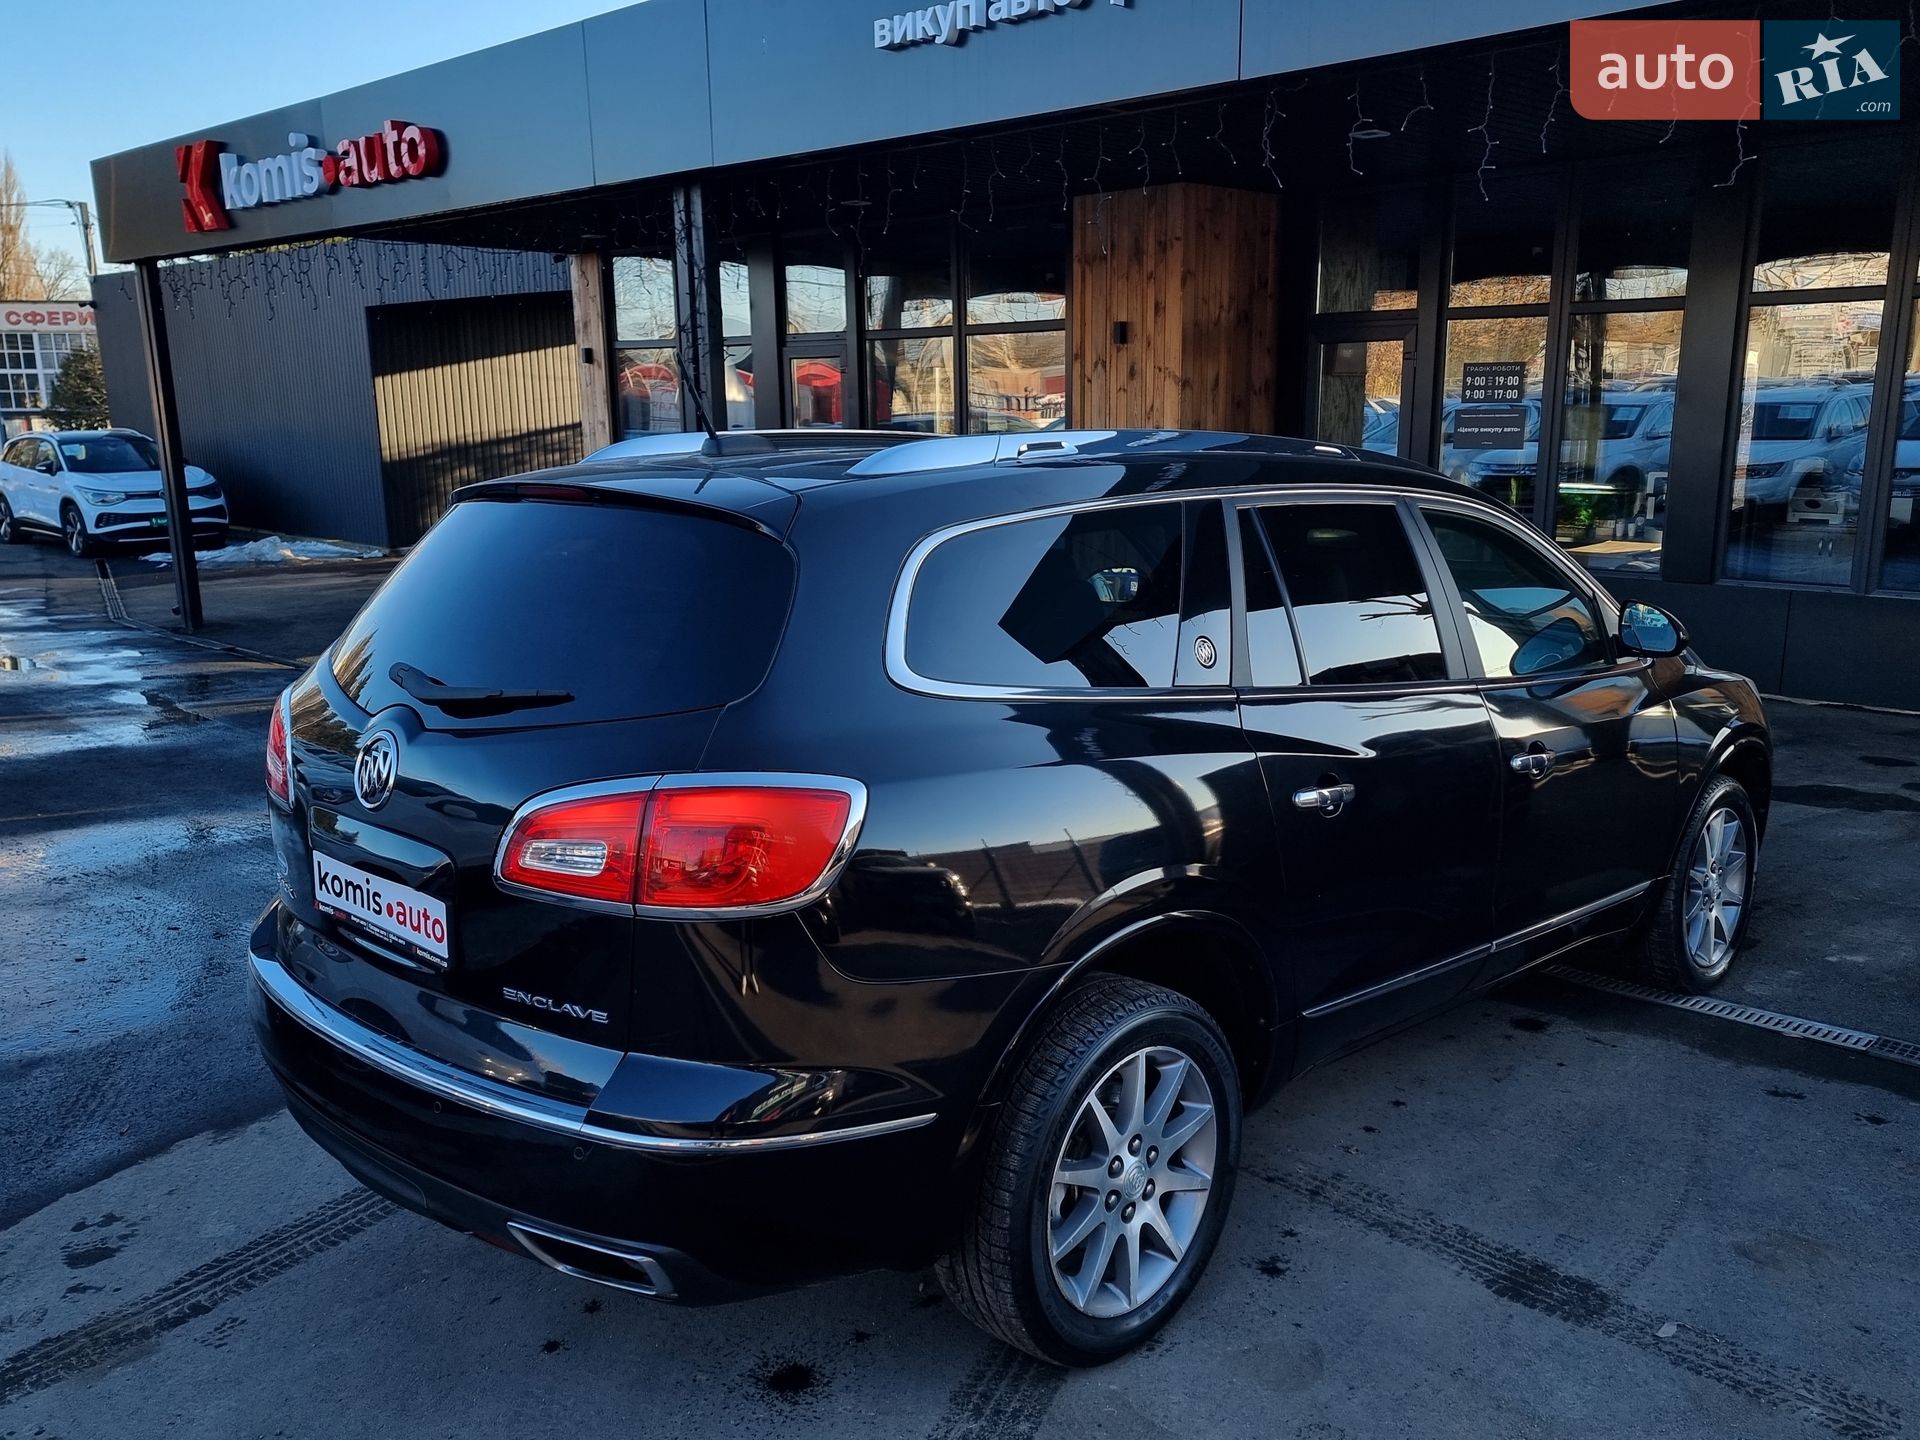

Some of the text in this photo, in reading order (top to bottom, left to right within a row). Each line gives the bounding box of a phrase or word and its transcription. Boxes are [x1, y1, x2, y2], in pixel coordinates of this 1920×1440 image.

[1466, 376, 1486, 386] 9:00
[1495, 376, 1519, 386] 19:00
[1465, 389, 1485, 399] 9:00
[1494, 389, 1518, 399] 17:00
[502, 987, 609, 1024] ENCLAVE
